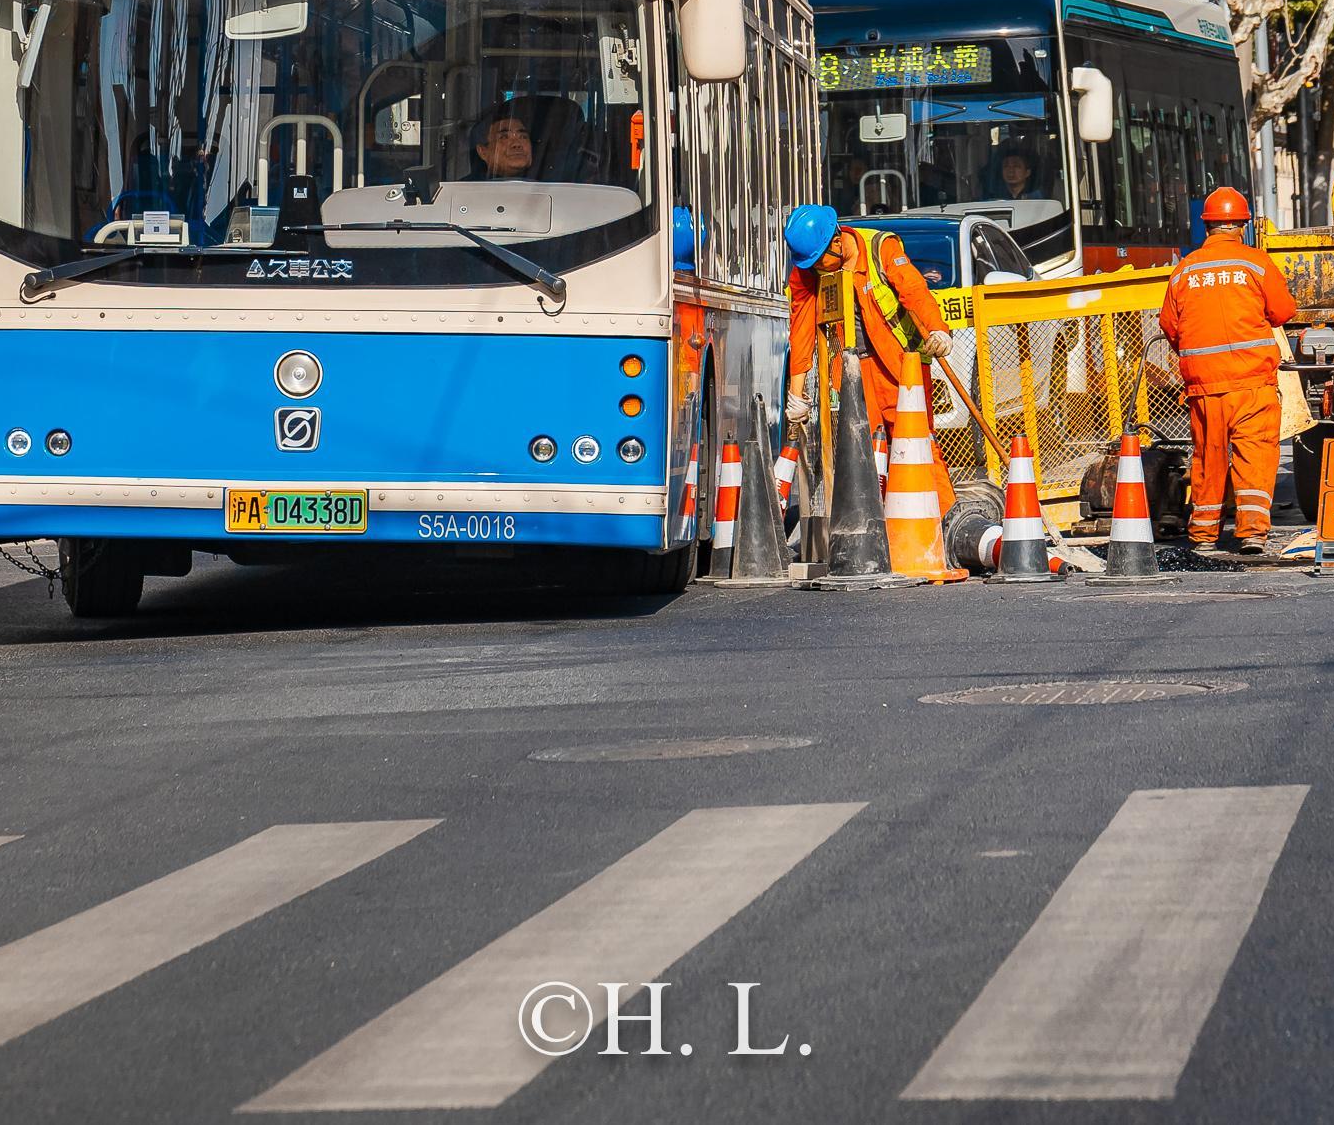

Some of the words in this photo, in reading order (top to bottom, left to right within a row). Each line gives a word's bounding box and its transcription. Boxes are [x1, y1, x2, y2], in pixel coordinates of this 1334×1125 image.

[870, 44, 979, 73] 南浦大桥
[266, 258, 353, 278] 久事公交
[1187, 270, 1248, 289] 松涛市政
[231, 495, 262, 525] 沪A
[273, 495, 363, 526] 04338D
[417, 514, 516, 539] S5A-0018
